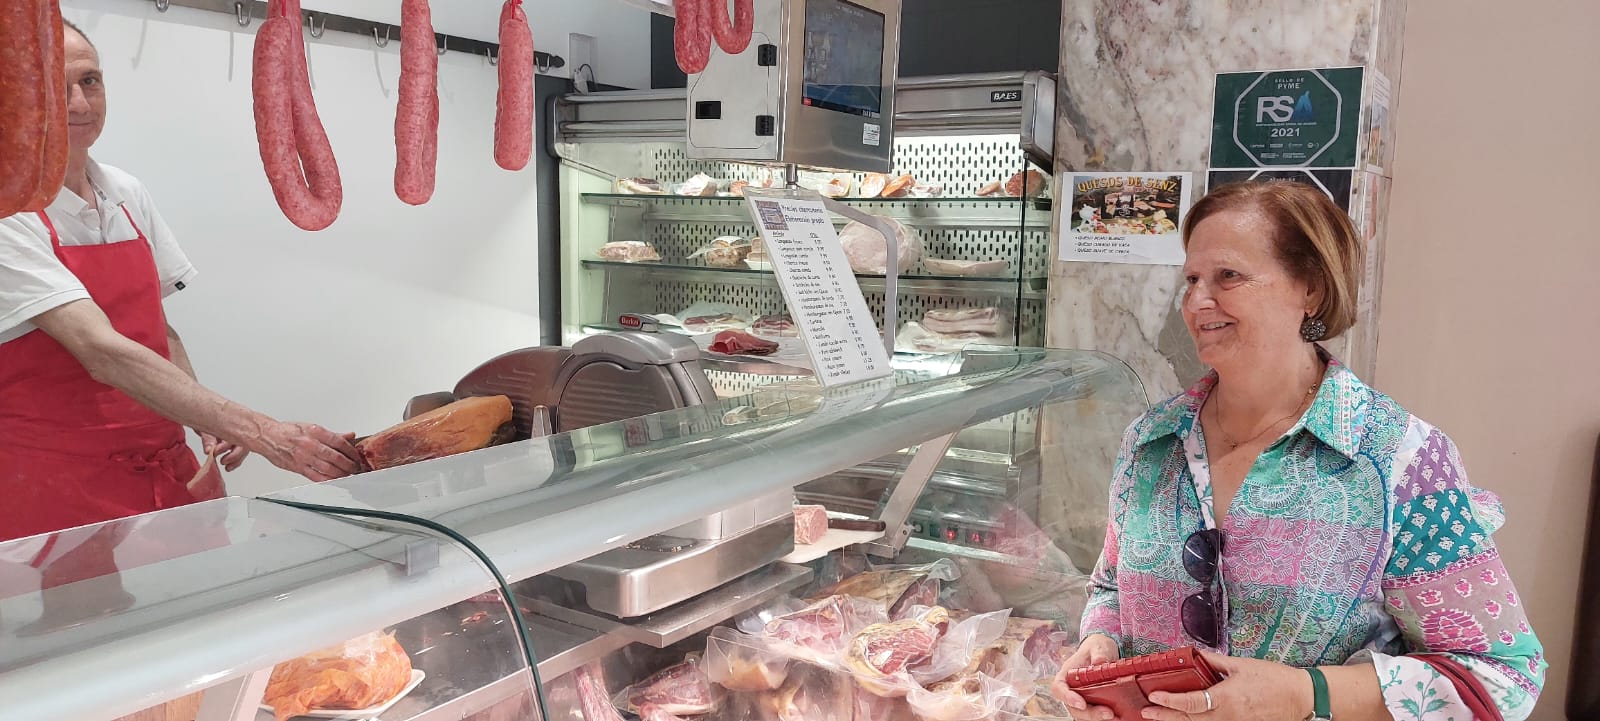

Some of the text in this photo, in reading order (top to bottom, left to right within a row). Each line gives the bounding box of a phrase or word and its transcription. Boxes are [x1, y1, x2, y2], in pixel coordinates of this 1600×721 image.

[1277, 82, 1301, 90] PYME
[993, 91, 1018, 101] BAES
[1270, 127, 1301, 138] 2021
[1077, 176, 1178, 193] QUESOS DE SENZ
